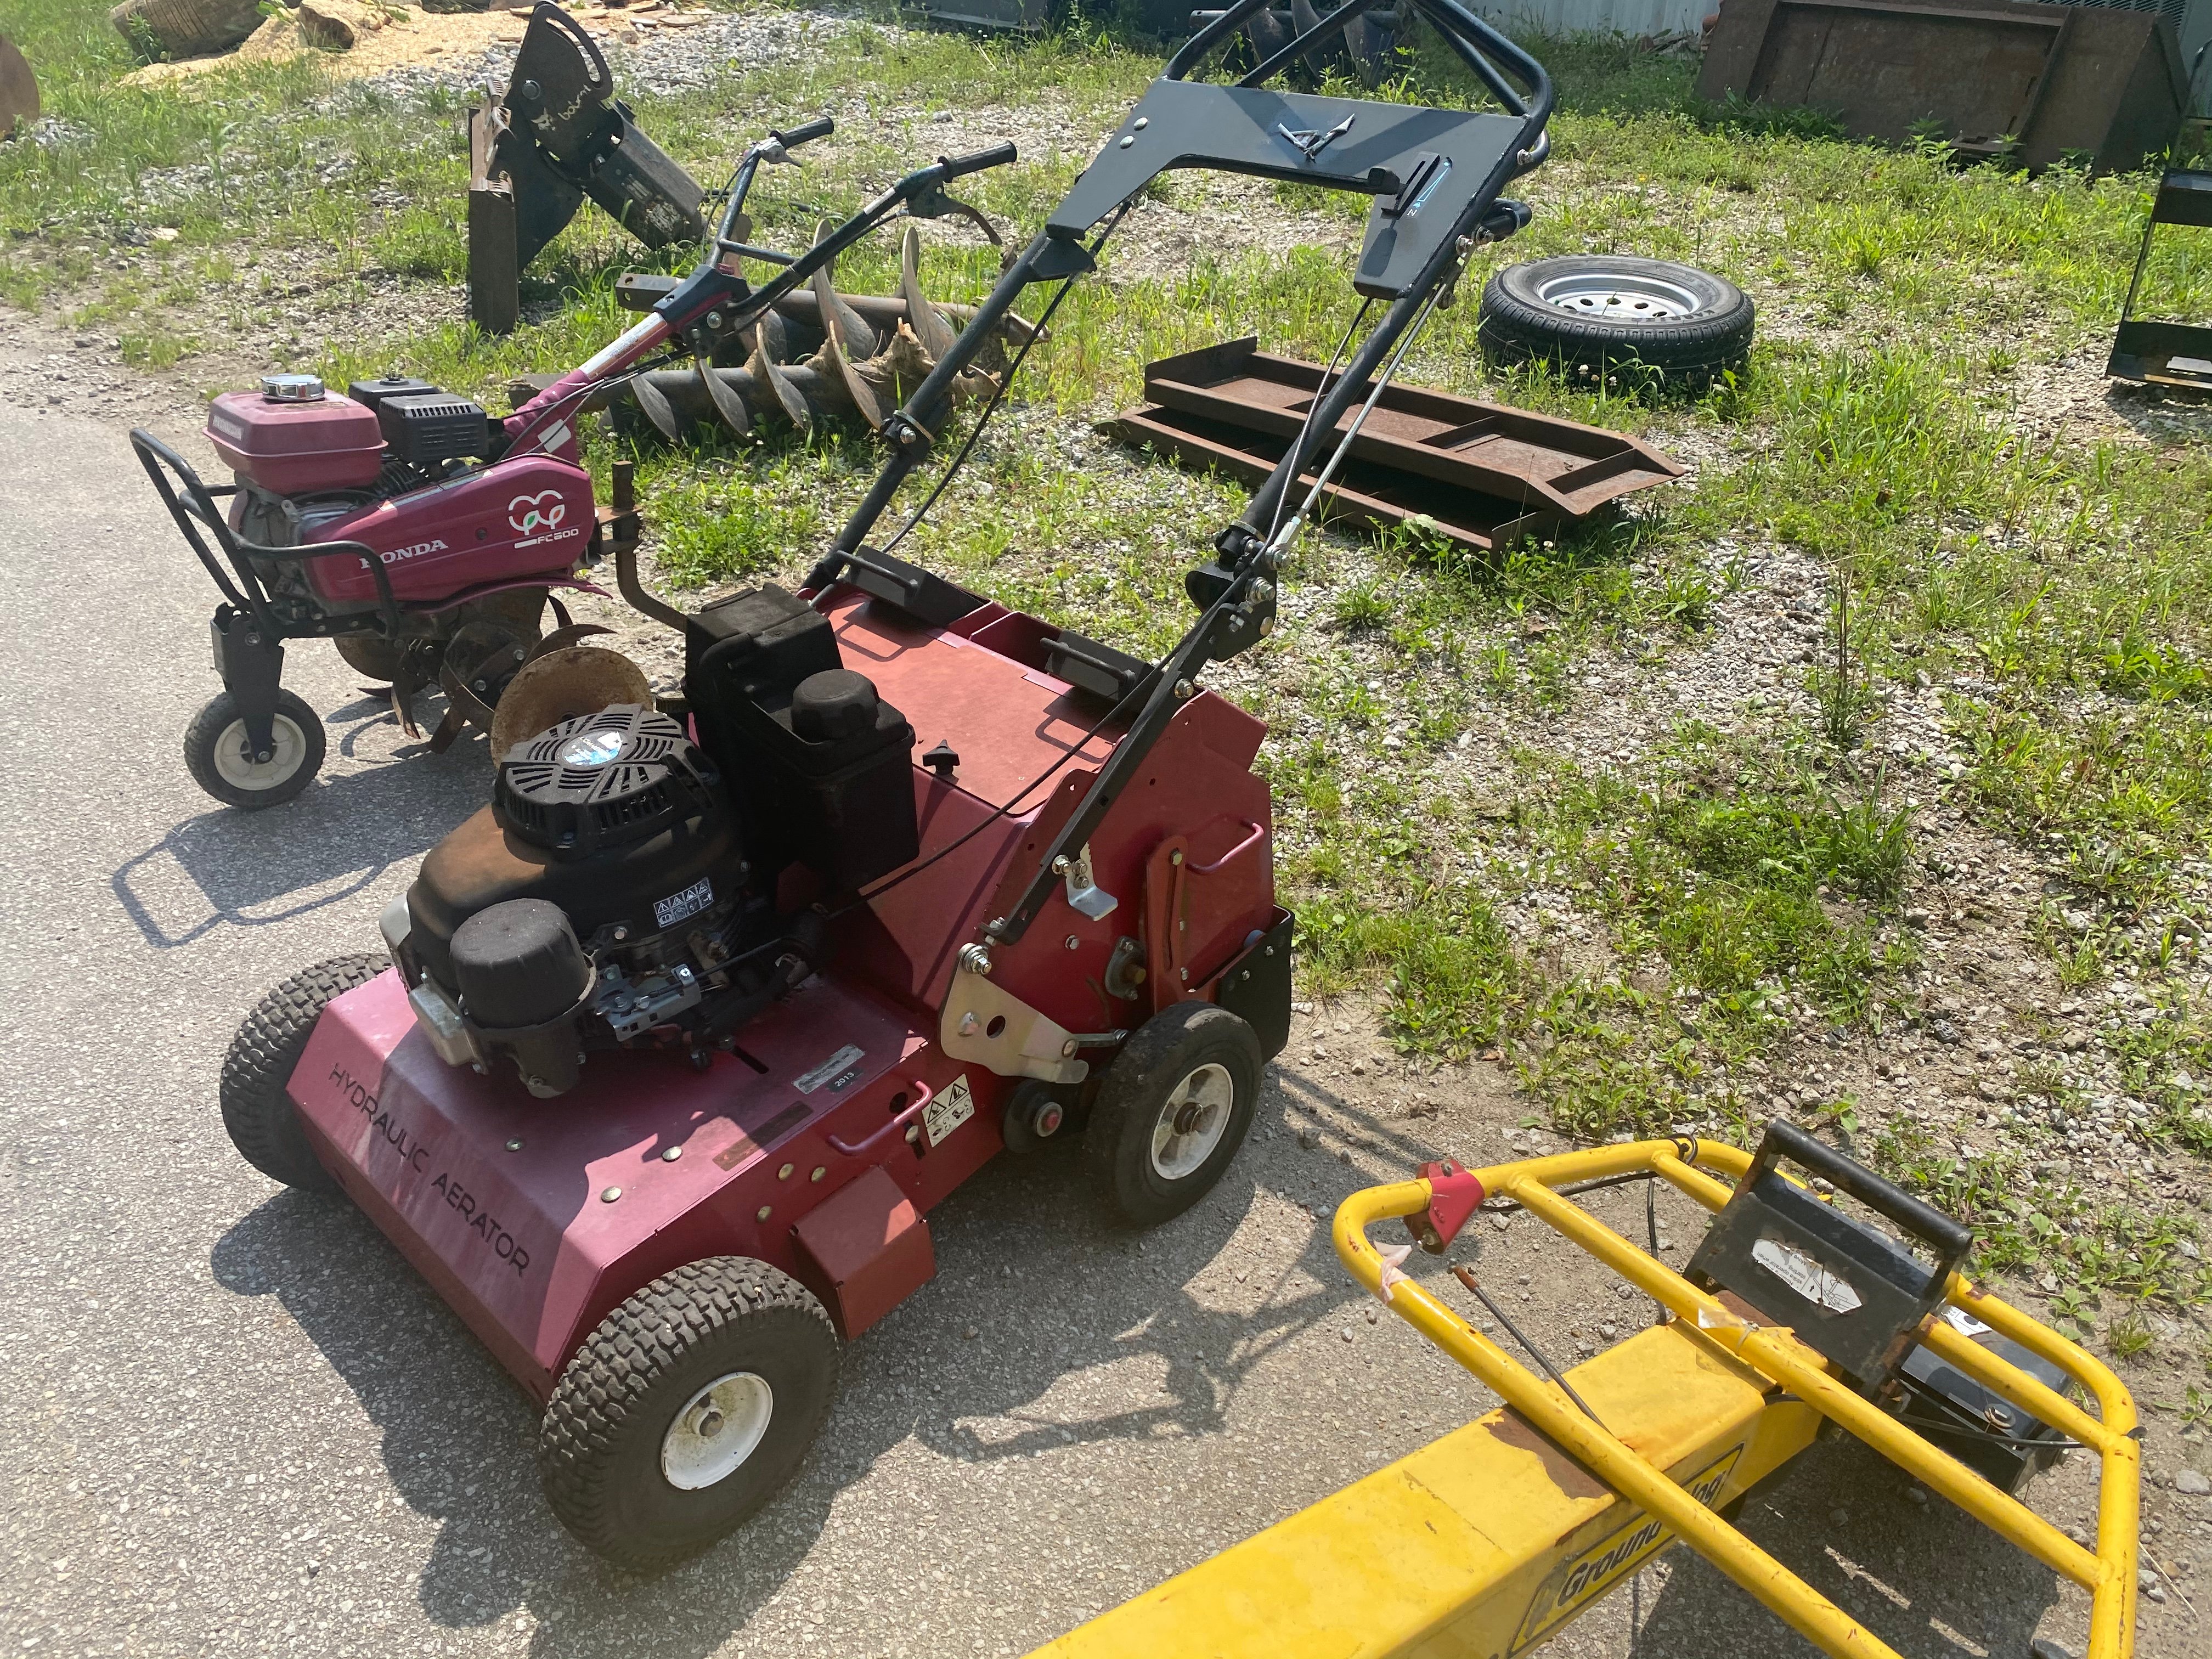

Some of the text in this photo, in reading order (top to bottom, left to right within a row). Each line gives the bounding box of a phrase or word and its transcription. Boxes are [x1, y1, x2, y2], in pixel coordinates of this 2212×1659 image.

[834, 1072, 855, 1087] 2013
[329, 1063, 530, 1278] HYDRAULIC AERATOR
[1757, 1252, 1803, 1284] strike operator when
[1793, 1255, 1807, 1266] Move
